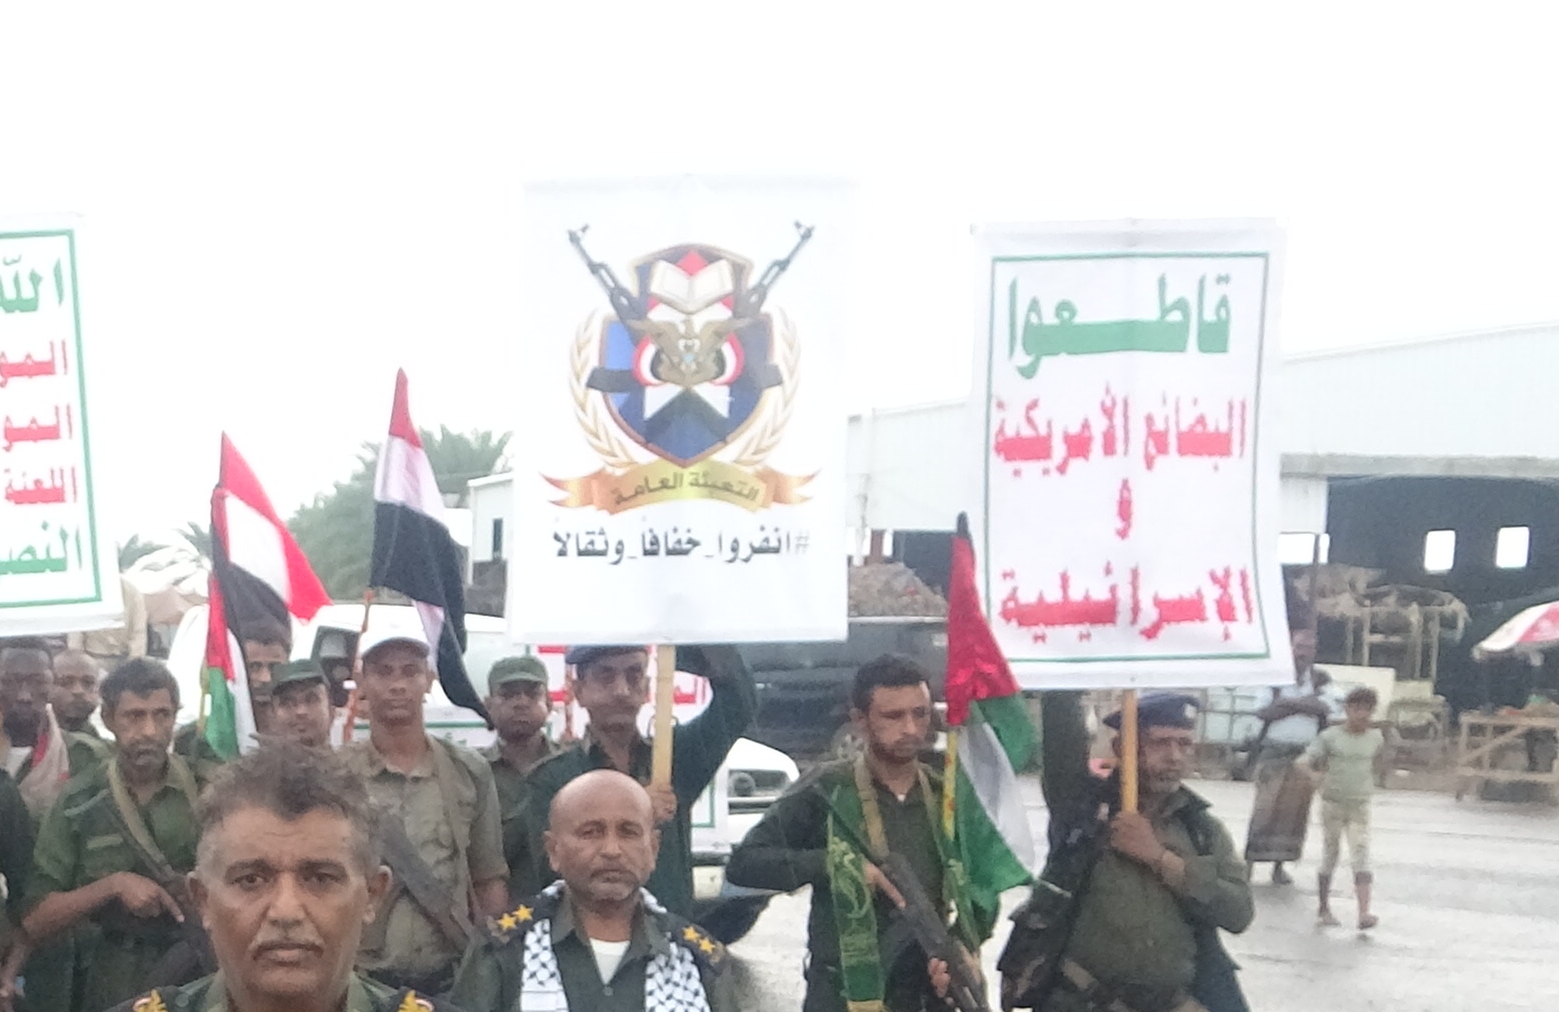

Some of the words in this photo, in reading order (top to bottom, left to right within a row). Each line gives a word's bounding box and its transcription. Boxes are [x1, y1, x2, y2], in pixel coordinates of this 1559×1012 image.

[1007, 272, 1233, 380] قاطعوا
[993, 382, 1131, 479] الأمريكية
[1142, 391, 1247, 472] البضائع
[4, 464, 79, 506] اللعنة
[610, 471, 685, 505] العامة
[1115, 478, 1134, 540] و
[999, 561, 1255, 644] الإسرائيلية
